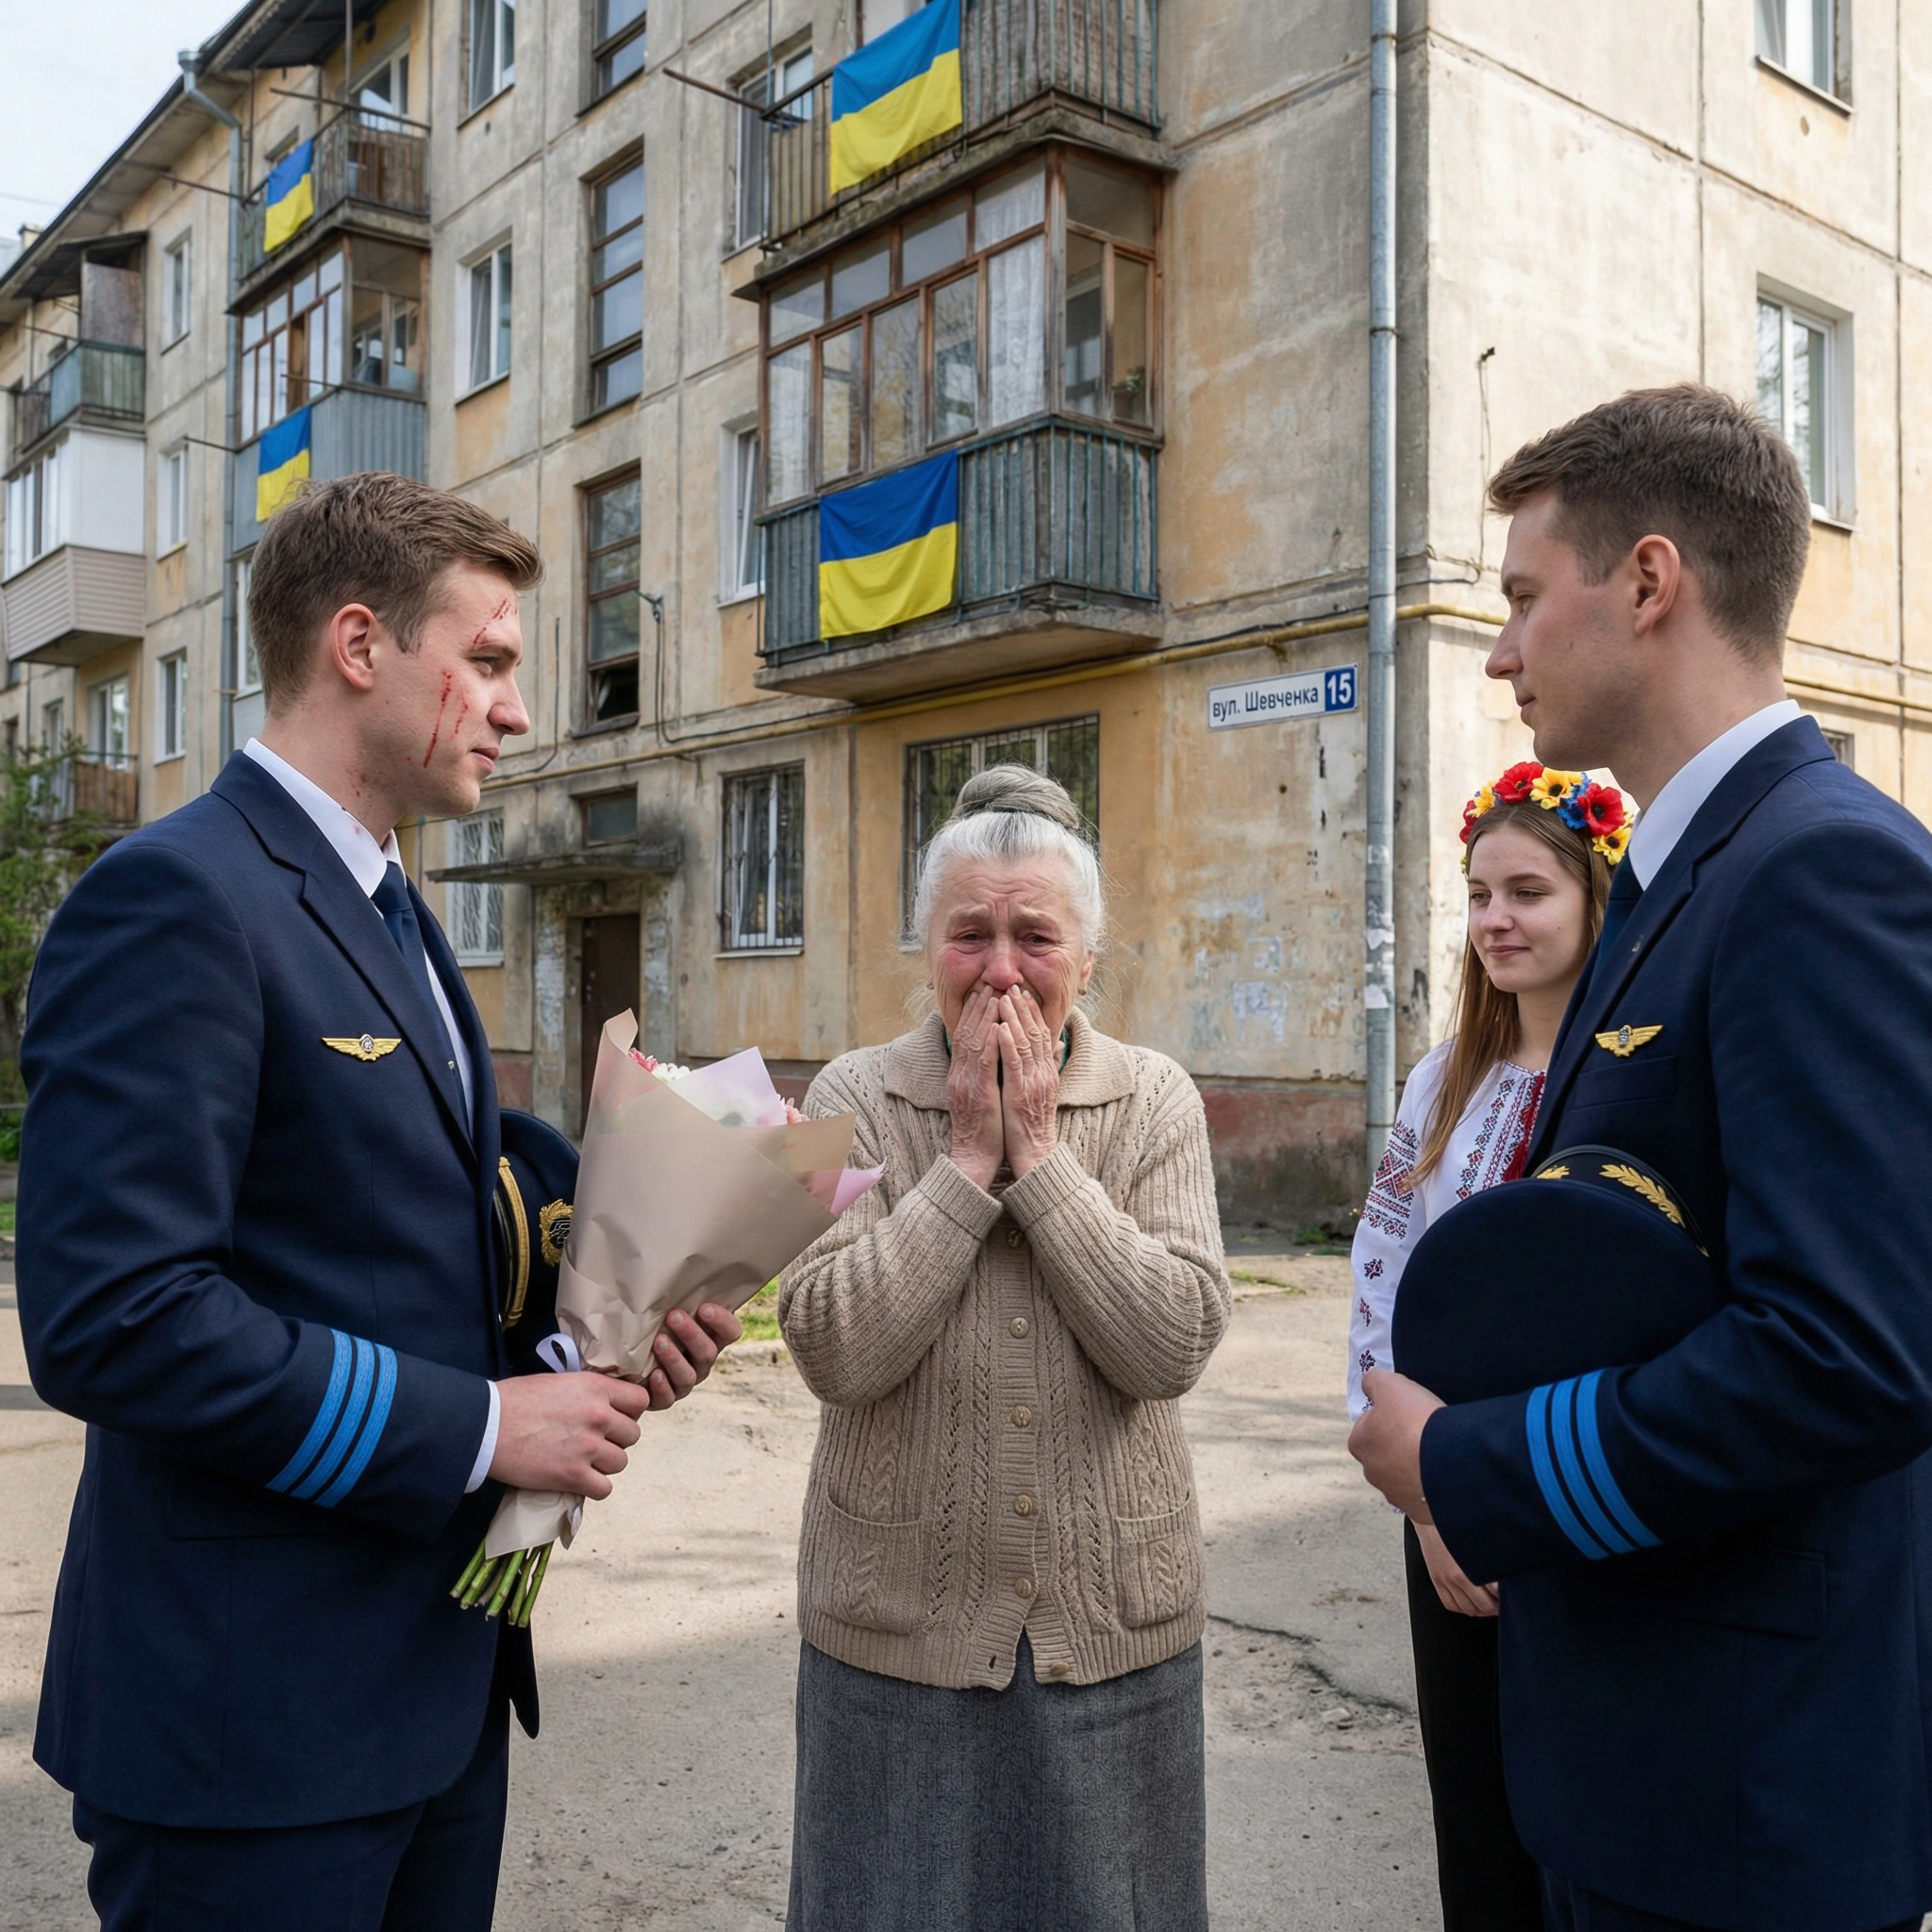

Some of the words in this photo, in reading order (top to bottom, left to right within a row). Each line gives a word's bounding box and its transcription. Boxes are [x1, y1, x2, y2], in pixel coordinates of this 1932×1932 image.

[1213, 699, 1241, 722] вул.
[1245, 687, 1319, 712] Шевченка
[1327, 672, 1352, 706] 15
